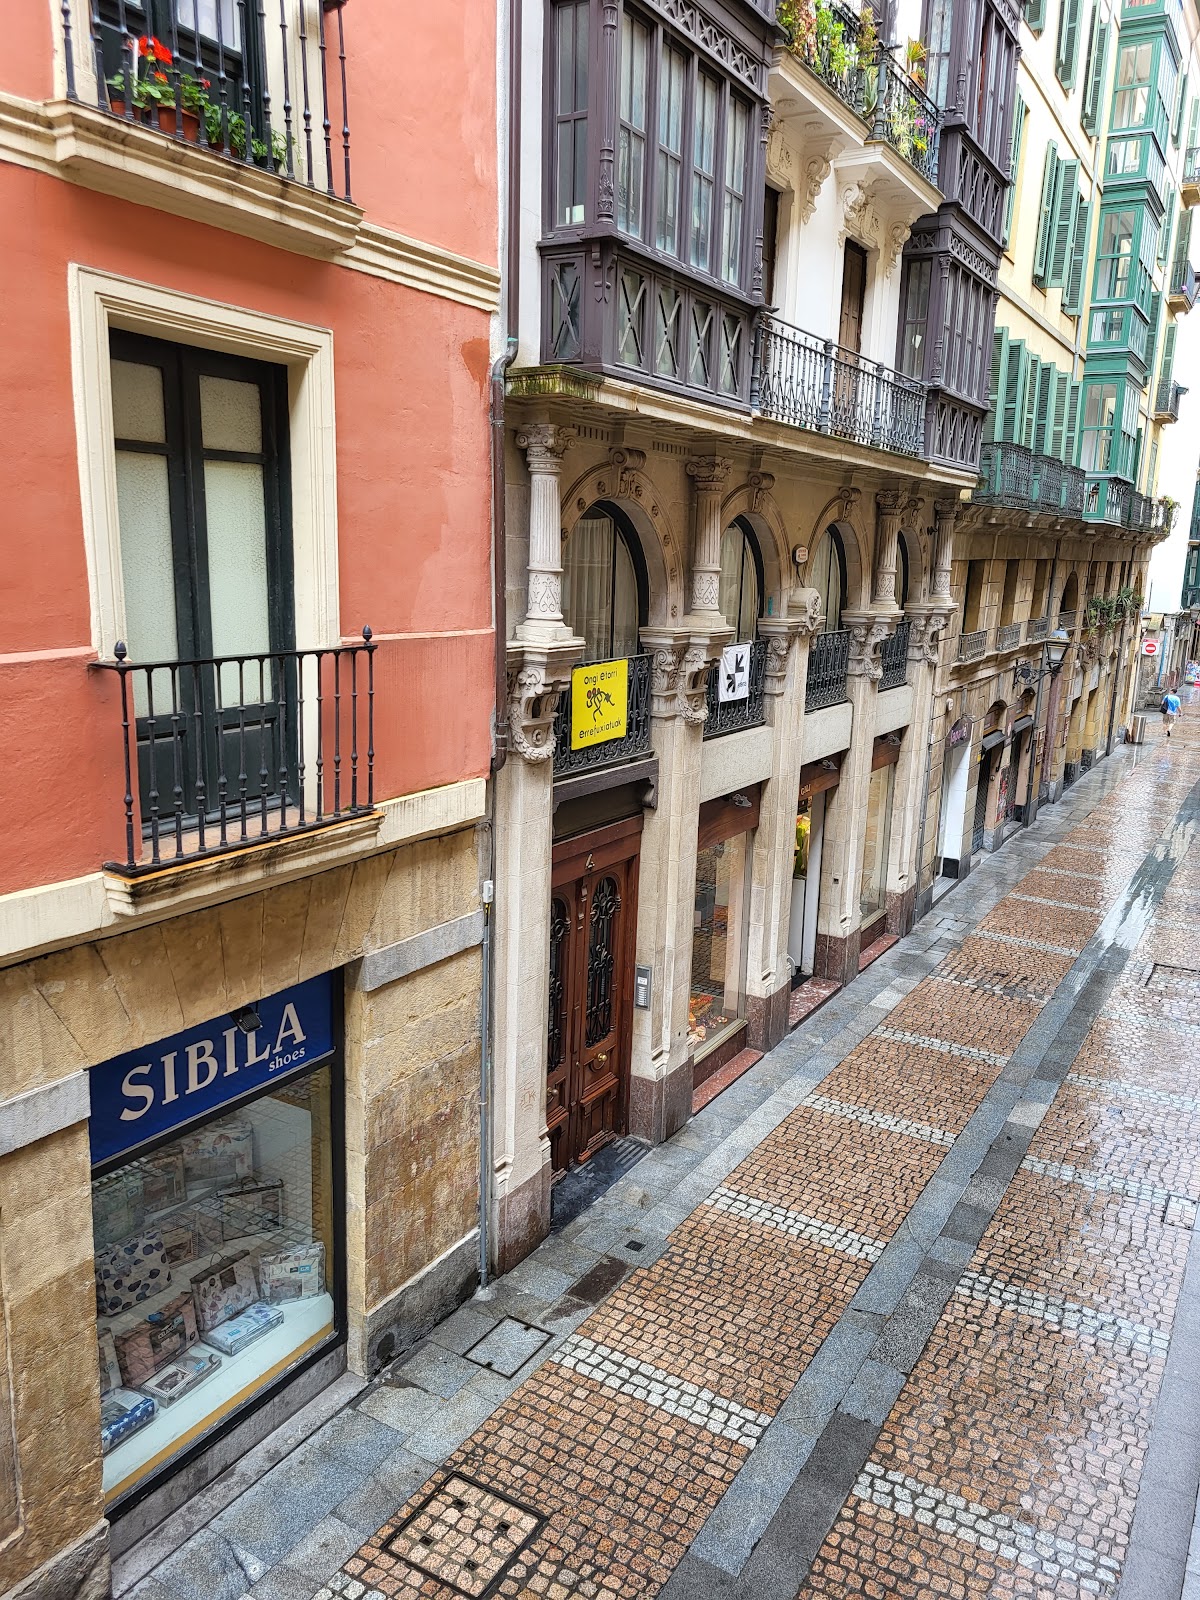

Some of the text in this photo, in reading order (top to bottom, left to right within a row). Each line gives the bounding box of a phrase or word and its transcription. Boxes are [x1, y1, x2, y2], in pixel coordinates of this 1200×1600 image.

[579, 717, 622, 739] errefuxiatuak
[119, 1002, 307, 1121] SIBILA
[268, 1046, 306, 1072] shoes
